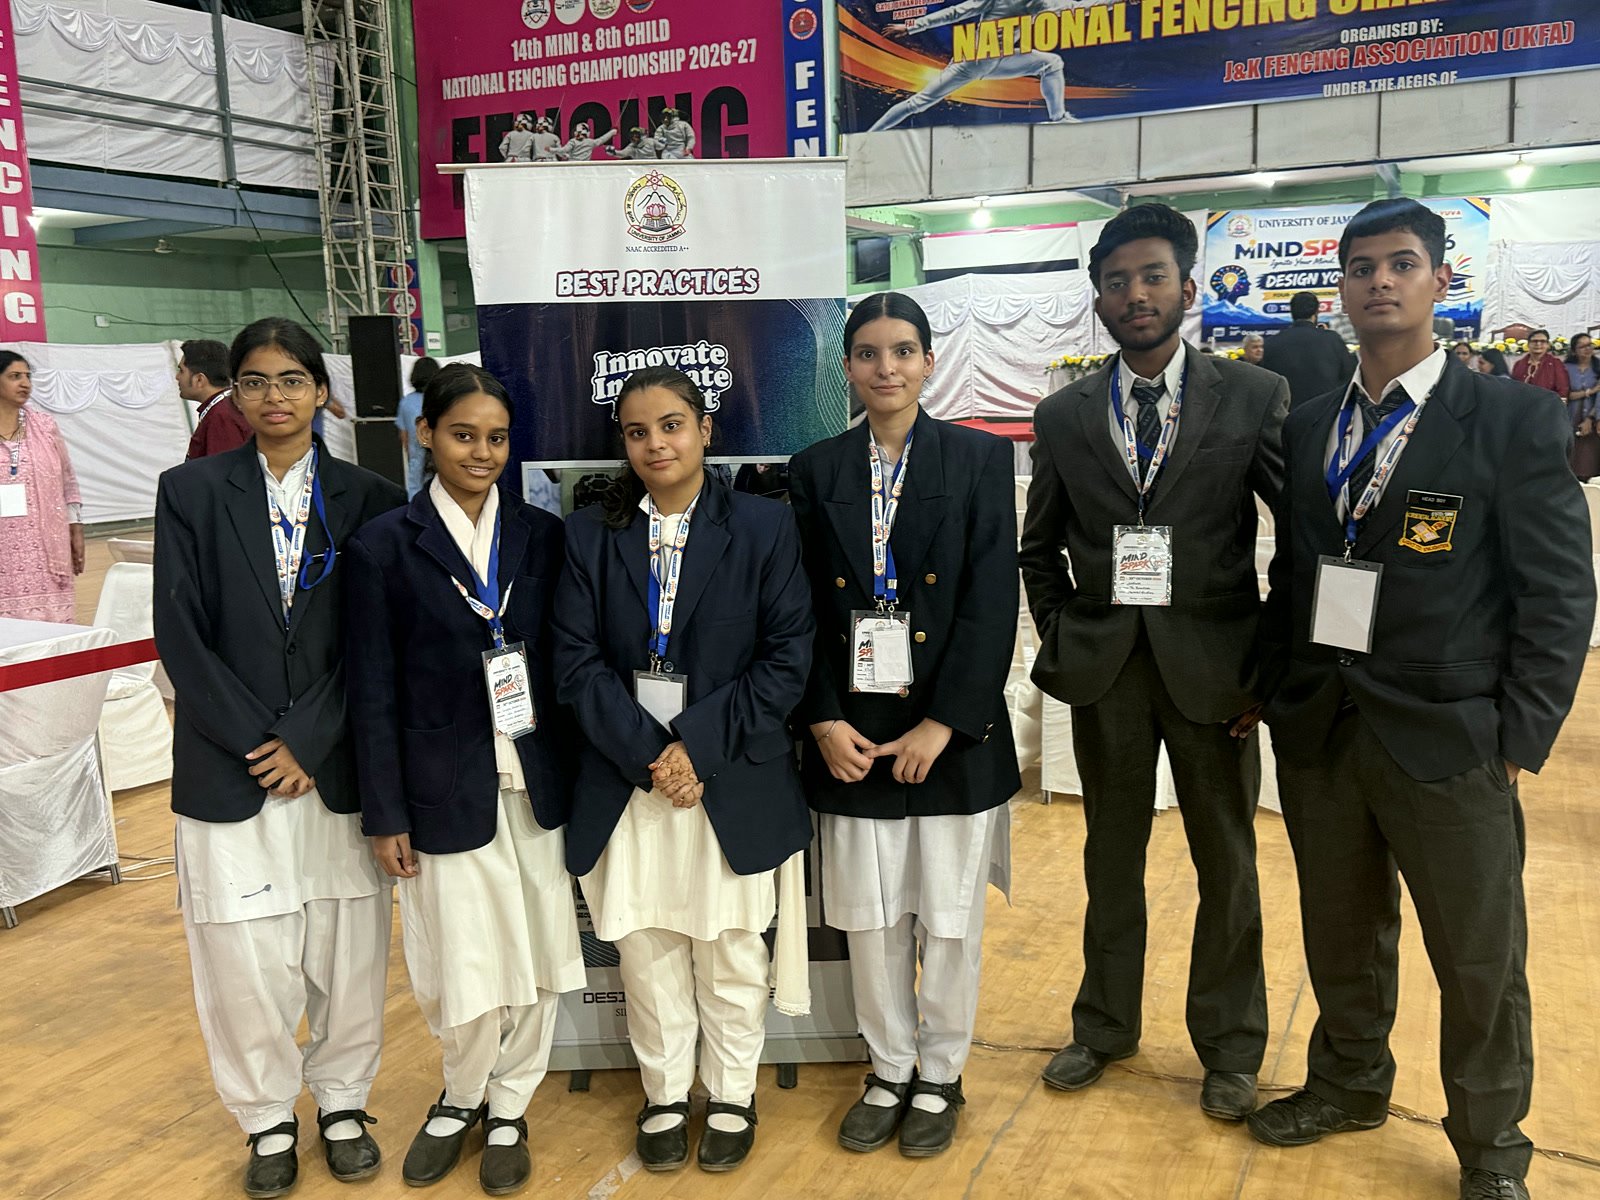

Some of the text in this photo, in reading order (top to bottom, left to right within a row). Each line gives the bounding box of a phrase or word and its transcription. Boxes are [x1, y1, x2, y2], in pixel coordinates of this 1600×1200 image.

[511, 18, 671, 61] 14th MINI & 8th CHILD
[953, 5, 1132, 63] NATIONAL
[1340, 18, 1443, 44] ORGANISED BY:
[1223, 20, 1575, 83] J&K FENCING ASSOCIATION (JKFA)
[442, 38, 758, 100] NATIONAL FENCING CHAMPIONSHIP 2026-27
[1258, 215, 1354, 229] UNIVERSITY OF JAM
[1234, 239, 1339, 260] MINDSP
[556, 268, 760, 297] BEST PRACTICES
[1265, 271, 1321, 289] DESIGN
[596, 343, 727, 377] Innovate
[1120, 559, 1150, 571] SPARK
[1121, 552, 1148, 564] MIND
[494, 674, 513, 691] MIND
[495, 681, 517, 699] SPARK
